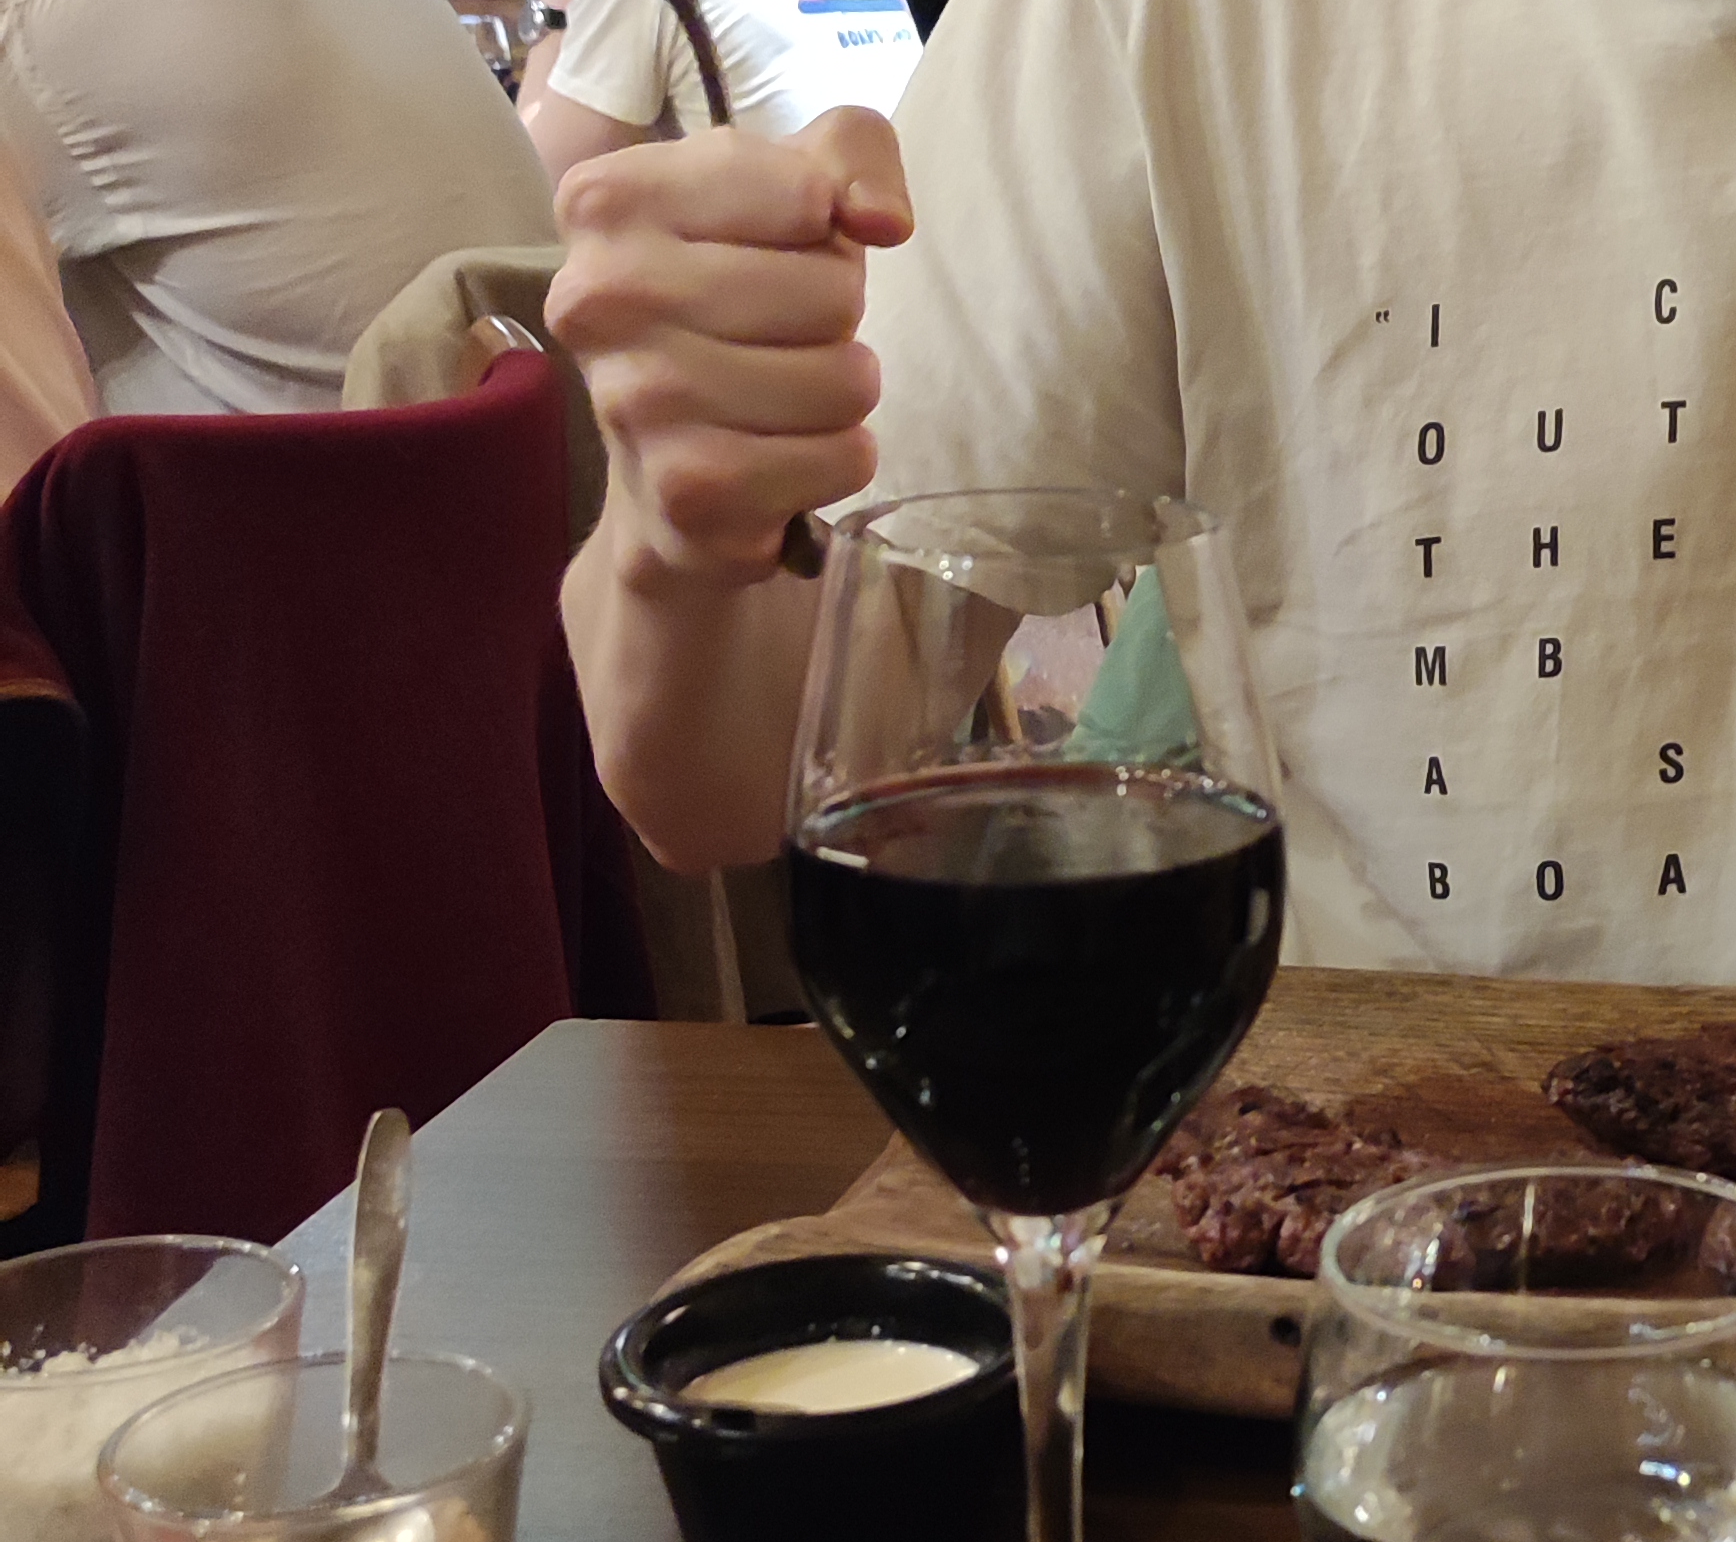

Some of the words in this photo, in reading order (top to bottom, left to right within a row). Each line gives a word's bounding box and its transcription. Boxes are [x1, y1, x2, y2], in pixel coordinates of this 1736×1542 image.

[1416, 398, 1688, 467] OUT
[1413, 516, 1678, 580] THE
[1422, 755, 1450, 797] A
